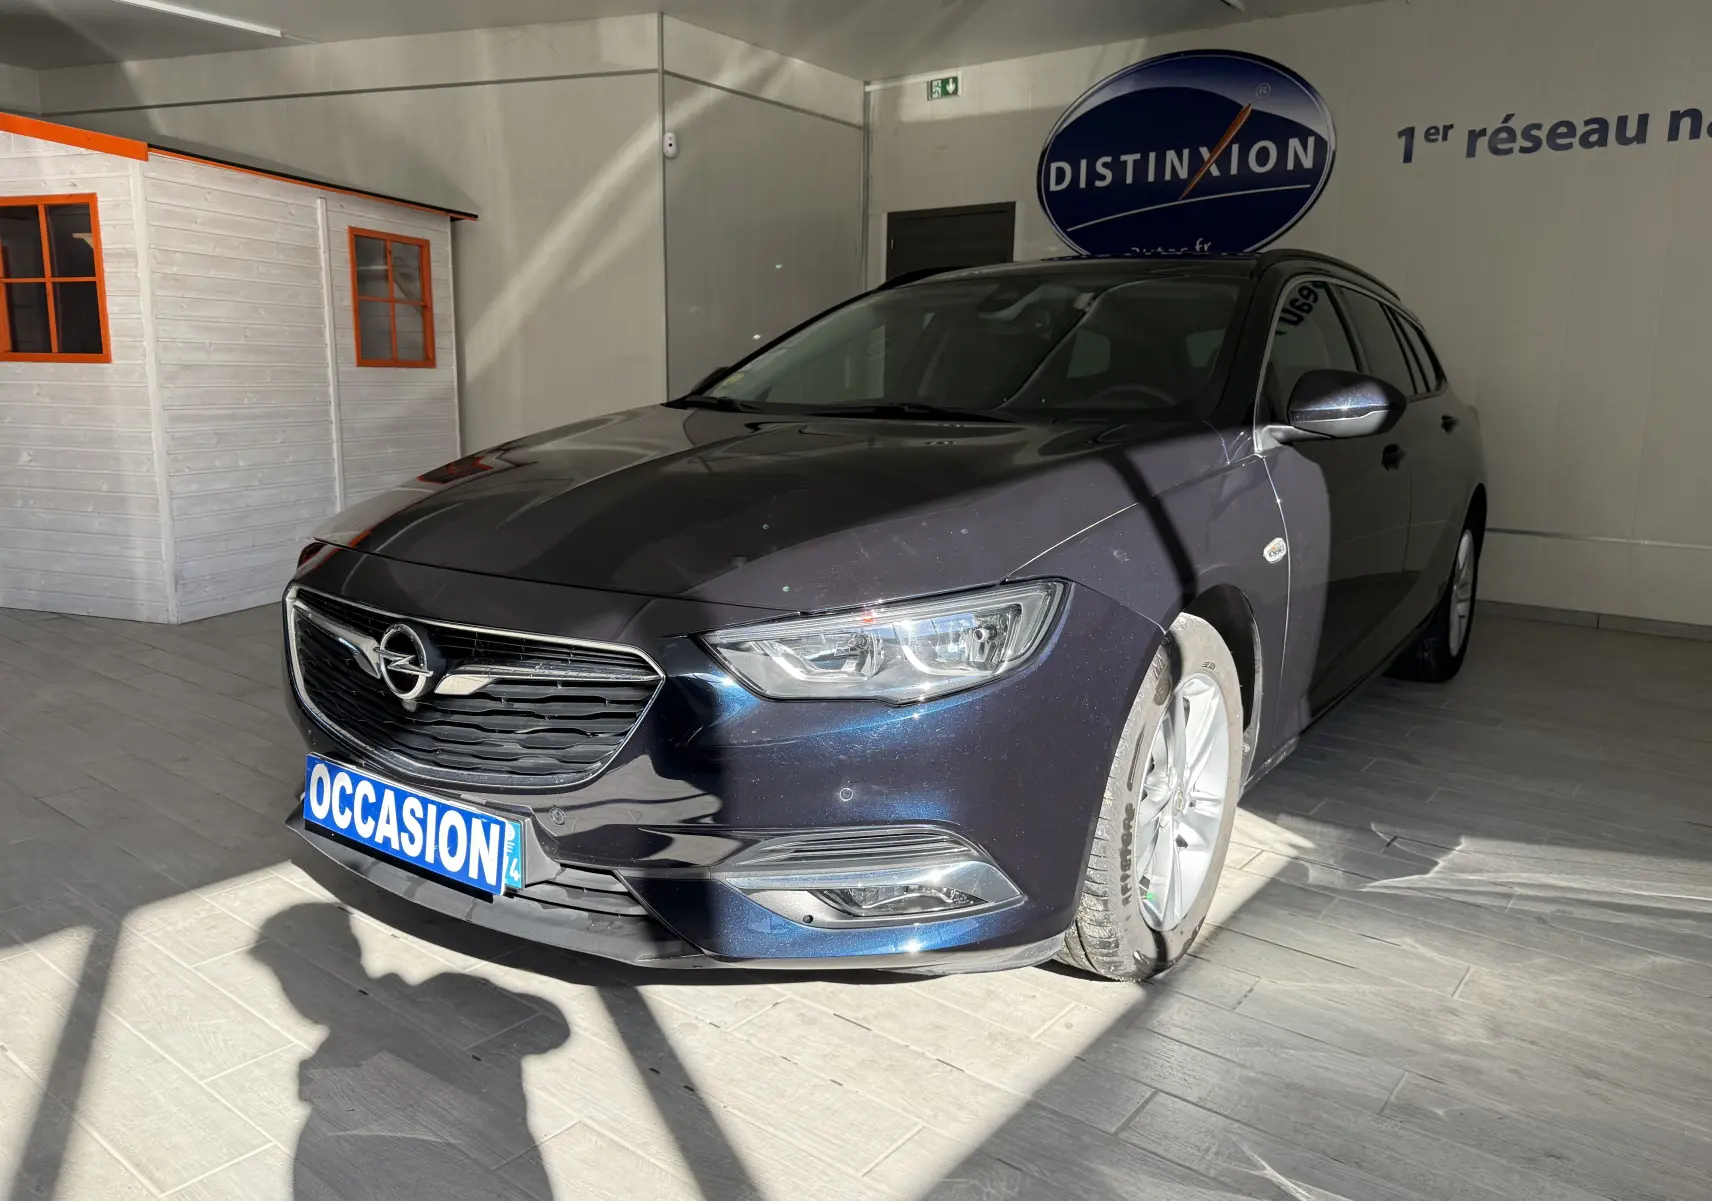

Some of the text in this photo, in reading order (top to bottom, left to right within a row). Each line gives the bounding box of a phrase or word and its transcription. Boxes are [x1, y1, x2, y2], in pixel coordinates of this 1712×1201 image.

[1465, 112, 1650, 159] réseau
[1050, 136, 1315, 191] DISTINXION
[309, 763, 501, 886] OCCASION
